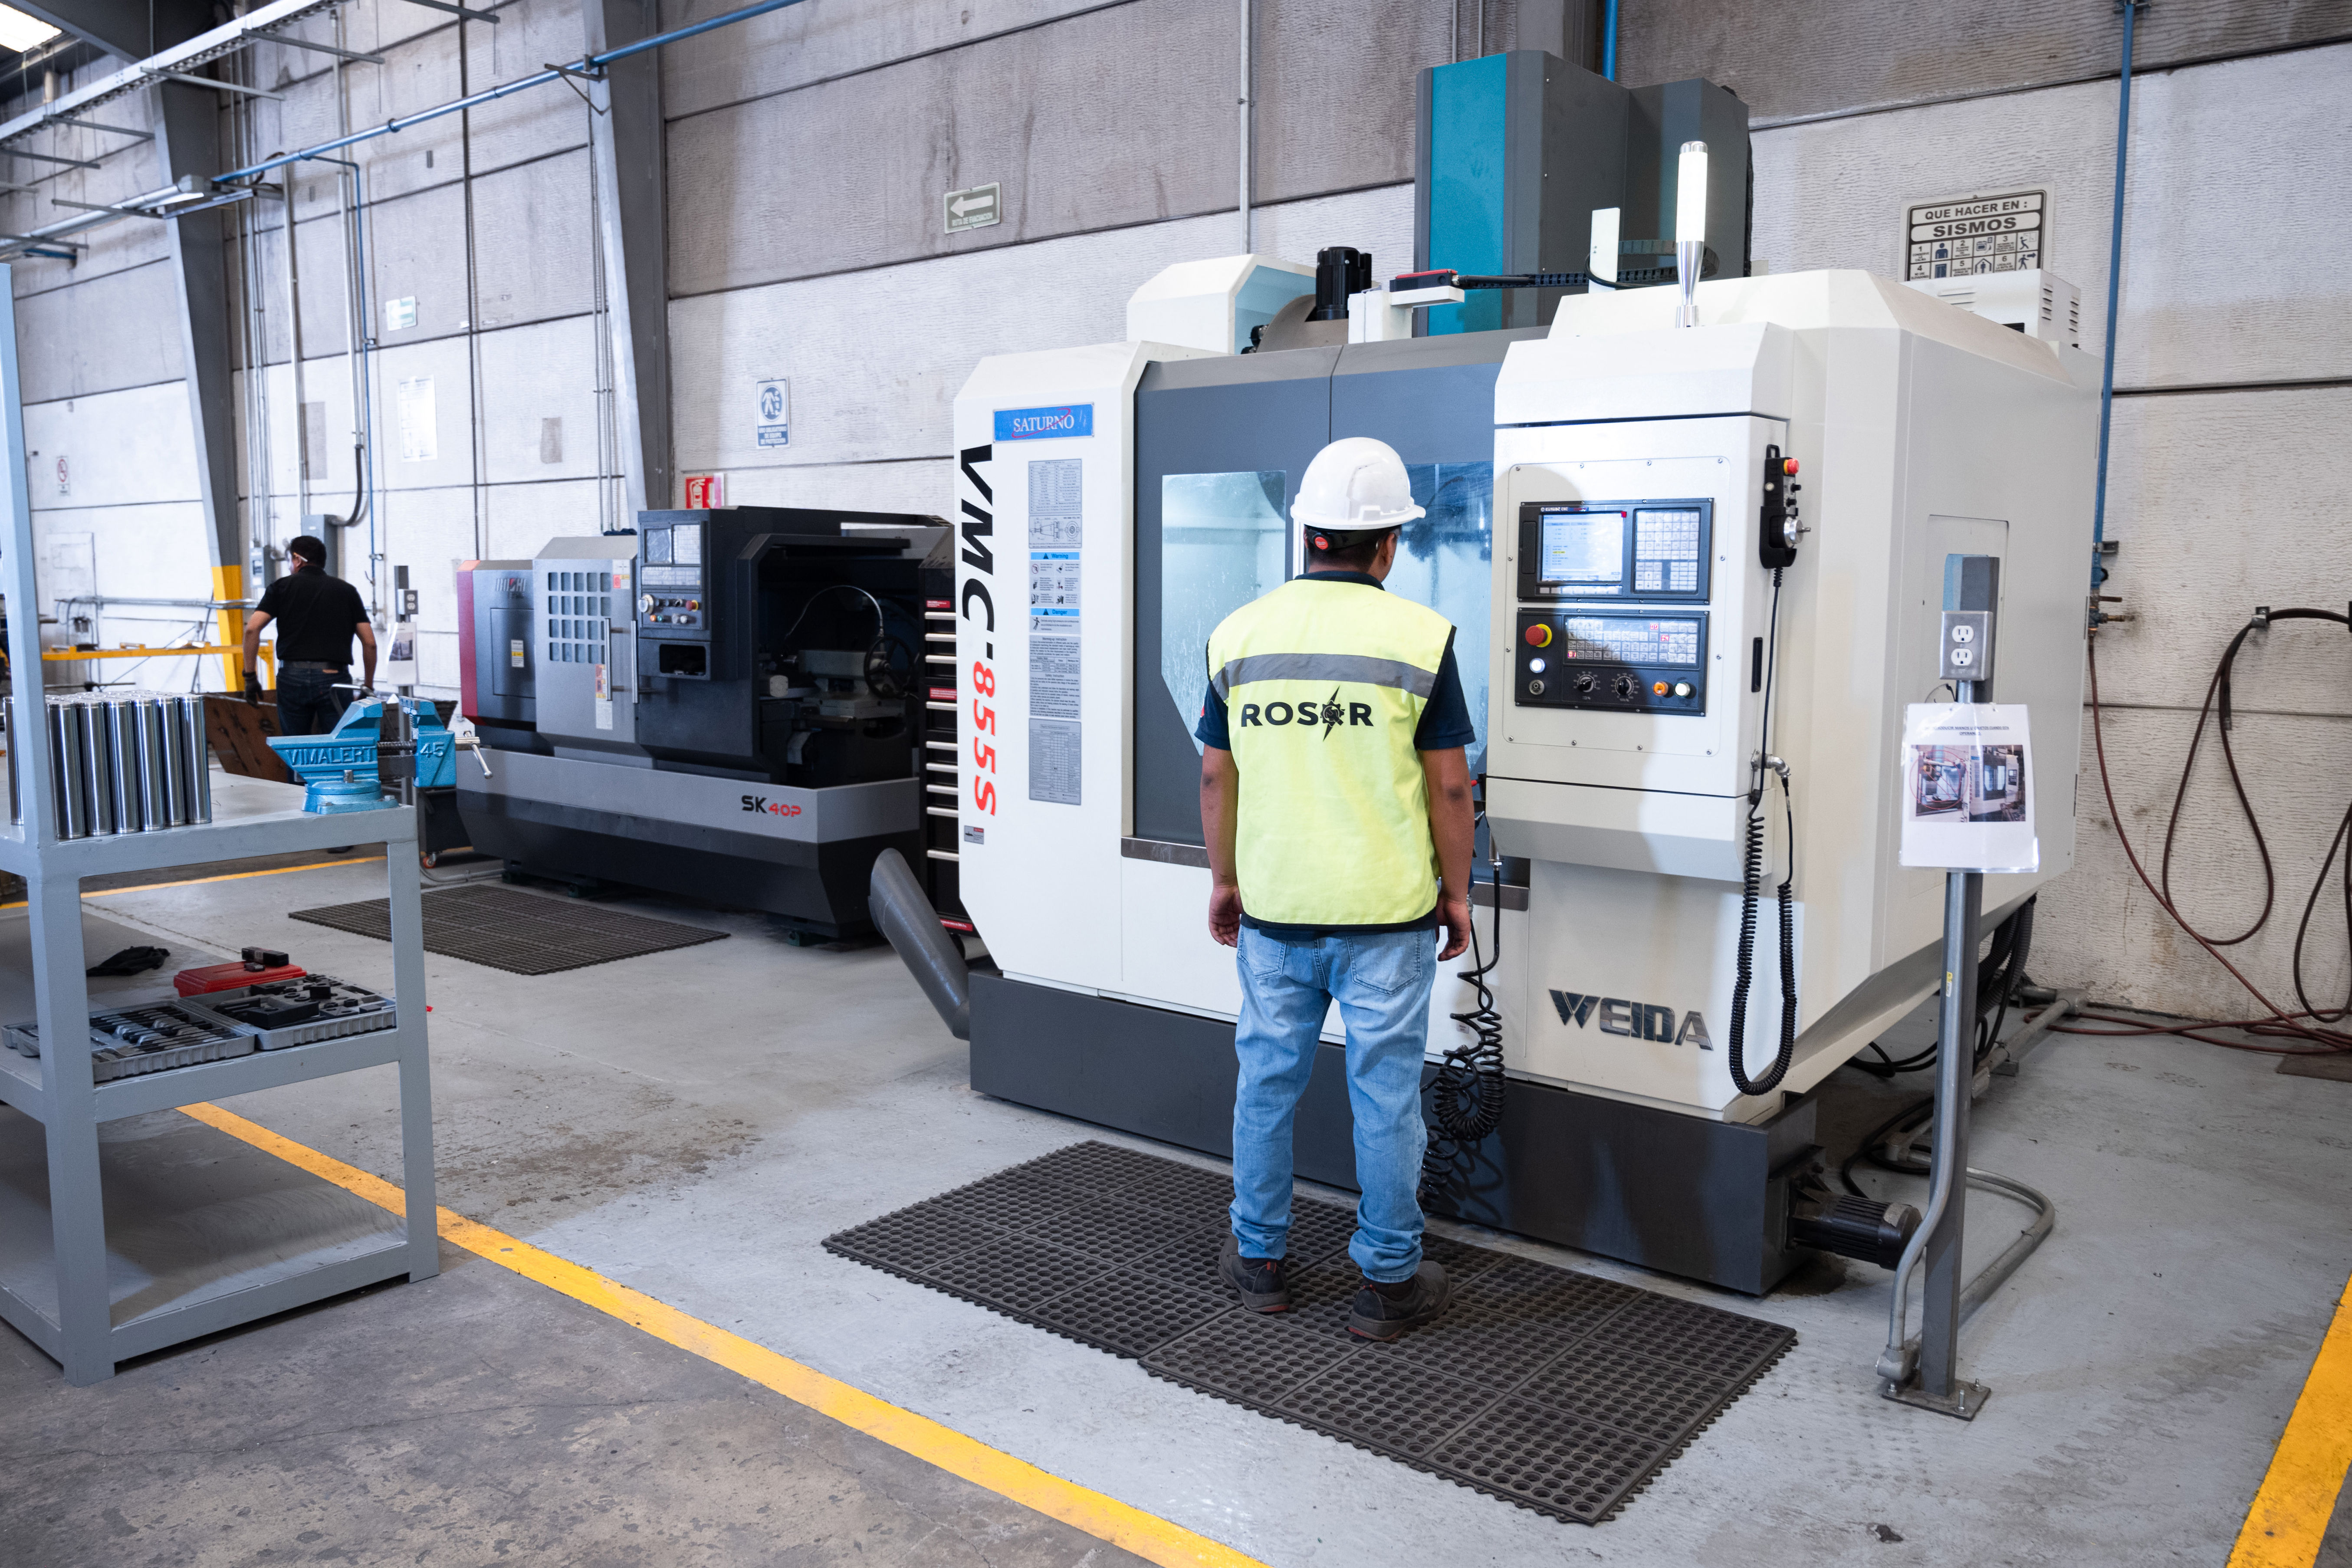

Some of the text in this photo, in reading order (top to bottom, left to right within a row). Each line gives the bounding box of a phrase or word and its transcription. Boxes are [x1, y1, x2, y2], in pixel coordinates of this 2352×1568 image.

[1925, 209, 1951, 220] QUE
[1955, 203, 1998, 217] HACER
[2002, 201, 2019, 211] EN
[1933, 217, 2017, 237] SISMOS
[1014, 414, 1074, 432] SATURNO
[961, 444, 996, 817] VMC-855S
[286, 745, 377, 766] VIMALERT
[420, 742, 445, 758] 45
[741, 795, 802, 817] SK40P
[1548, 988, 1714, 1051] WEIDA
